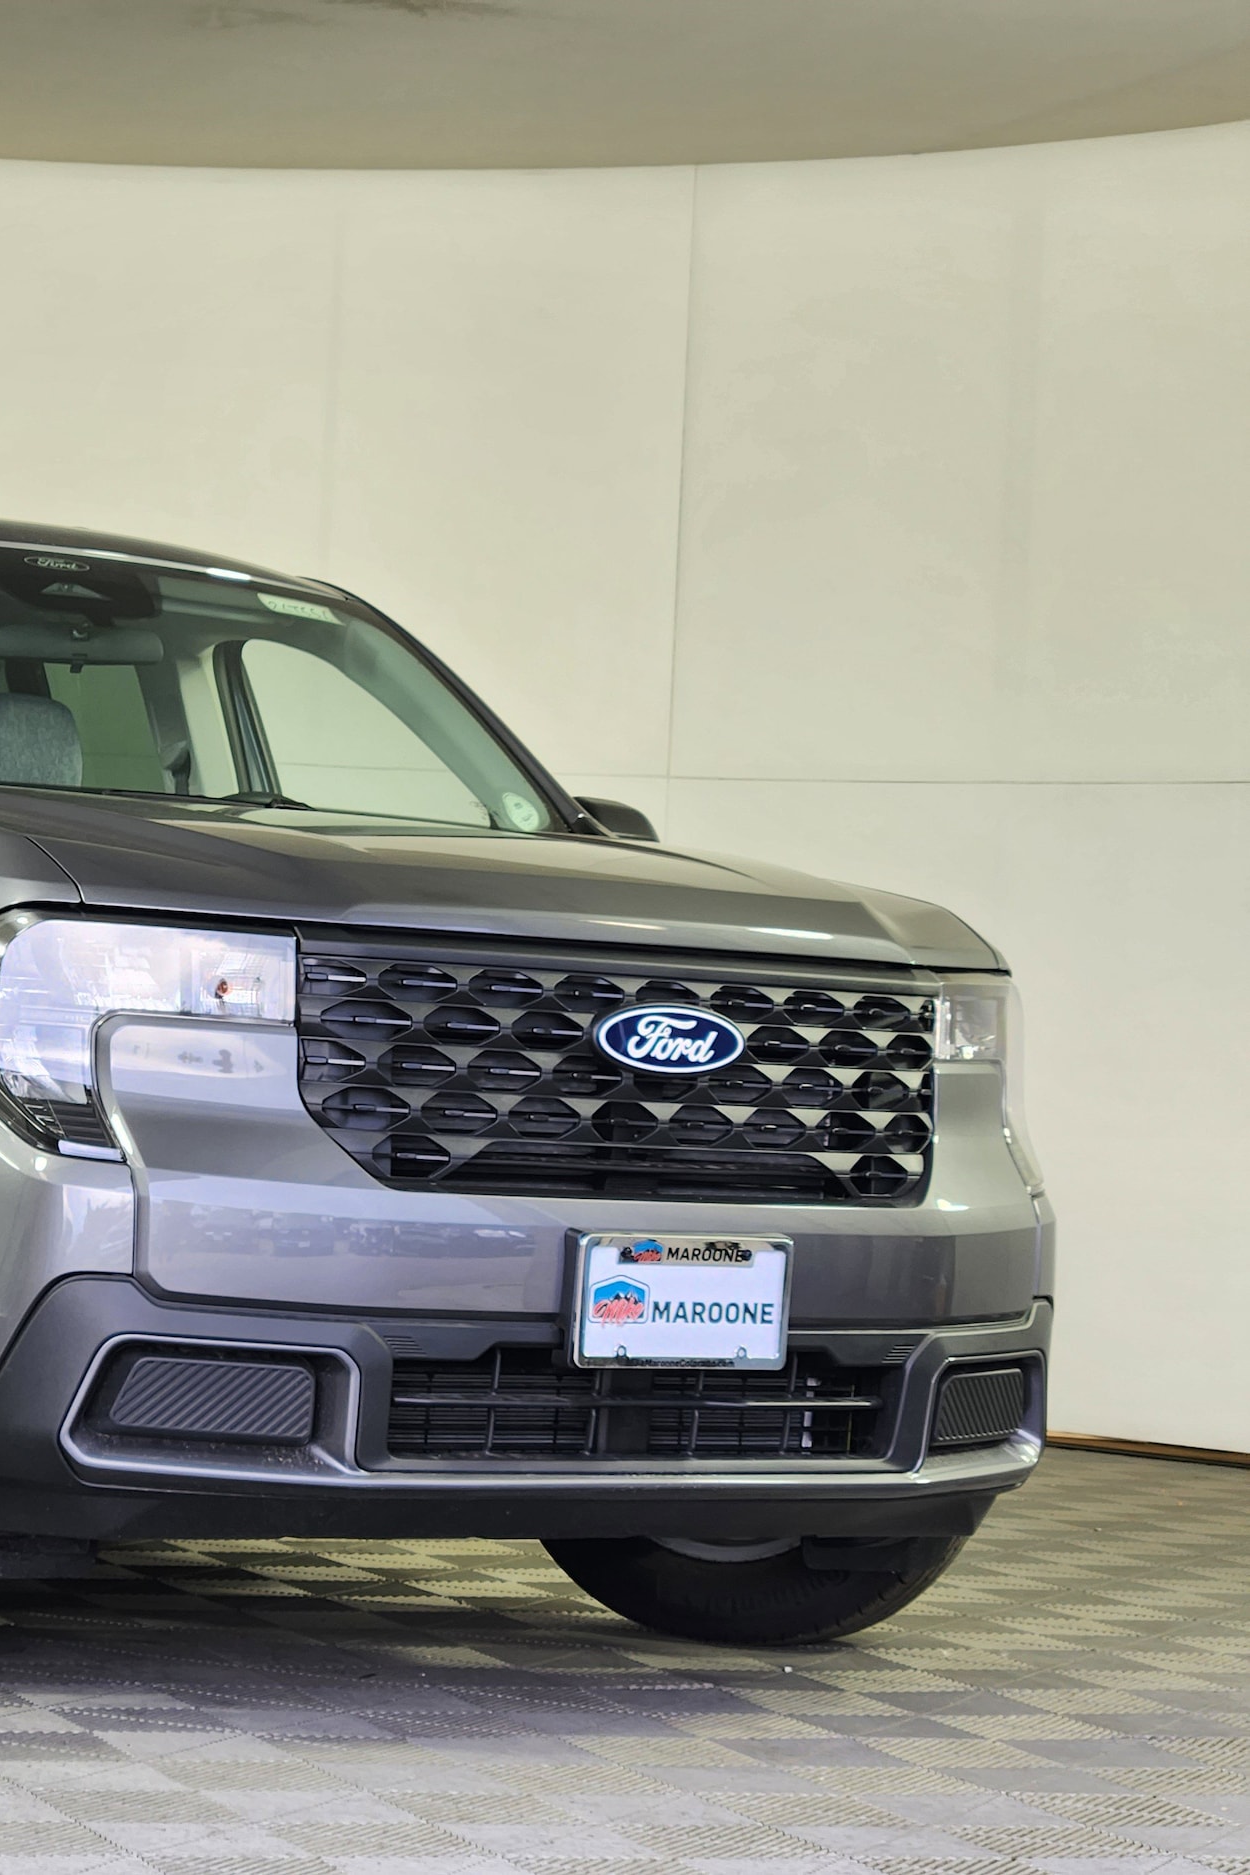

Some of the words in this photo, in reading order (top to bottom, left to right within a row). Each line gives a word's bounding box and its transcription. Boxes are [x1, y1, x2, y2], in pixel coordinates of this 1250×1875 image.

[627, 1015, 718, 1063] Ford
[666, 1247, 744, 1263] MAROONE
[651, 1301, 775, 1325] MAROONE
